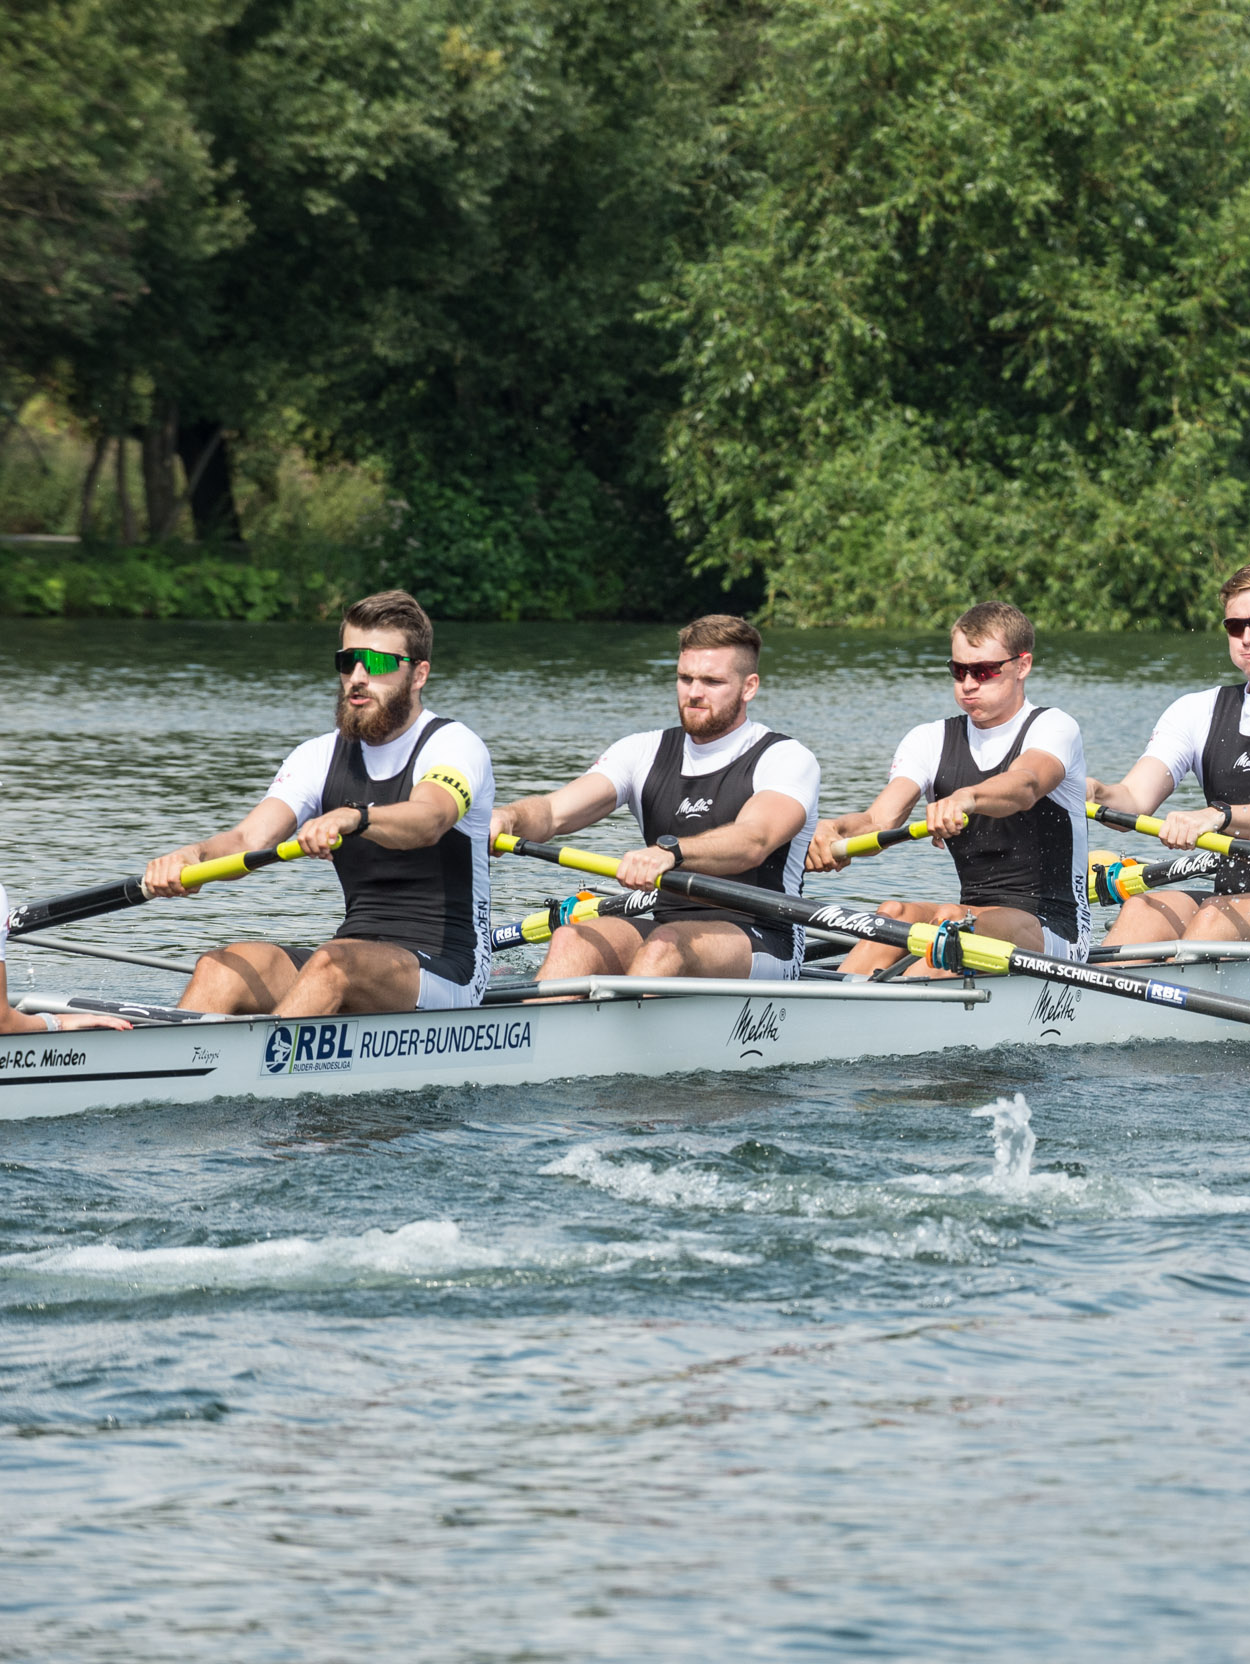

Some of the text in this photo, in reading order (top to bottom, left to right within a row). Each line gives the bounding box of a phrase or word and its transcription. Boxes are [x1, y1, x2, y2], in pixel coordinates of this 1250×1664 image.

[1167, 850, 1218, 880] Melitta
[495, 925, 521, 941] RBL
[808, 904, 877, 937] Melitta
[1014, 954, 1056, 975] STARK.
[1056, 964, 1113, 988] SCHNELL.
[1114, 978, 1143, 994] GUT.
[1151, 983, 1184, 1002] RBL
[1028, 979, 1077, 1025] Melitta
[726, 997, 781, 1047] Melitta
[40, 1047, 87, 1068] Minden
[294, 1023, 354, 1061] RBL
[359, 1021, 532, 1059] RUDER-BUNDESLIGA
[292, 1060, 351, 1073] RUDER-BUNDESLIGA
